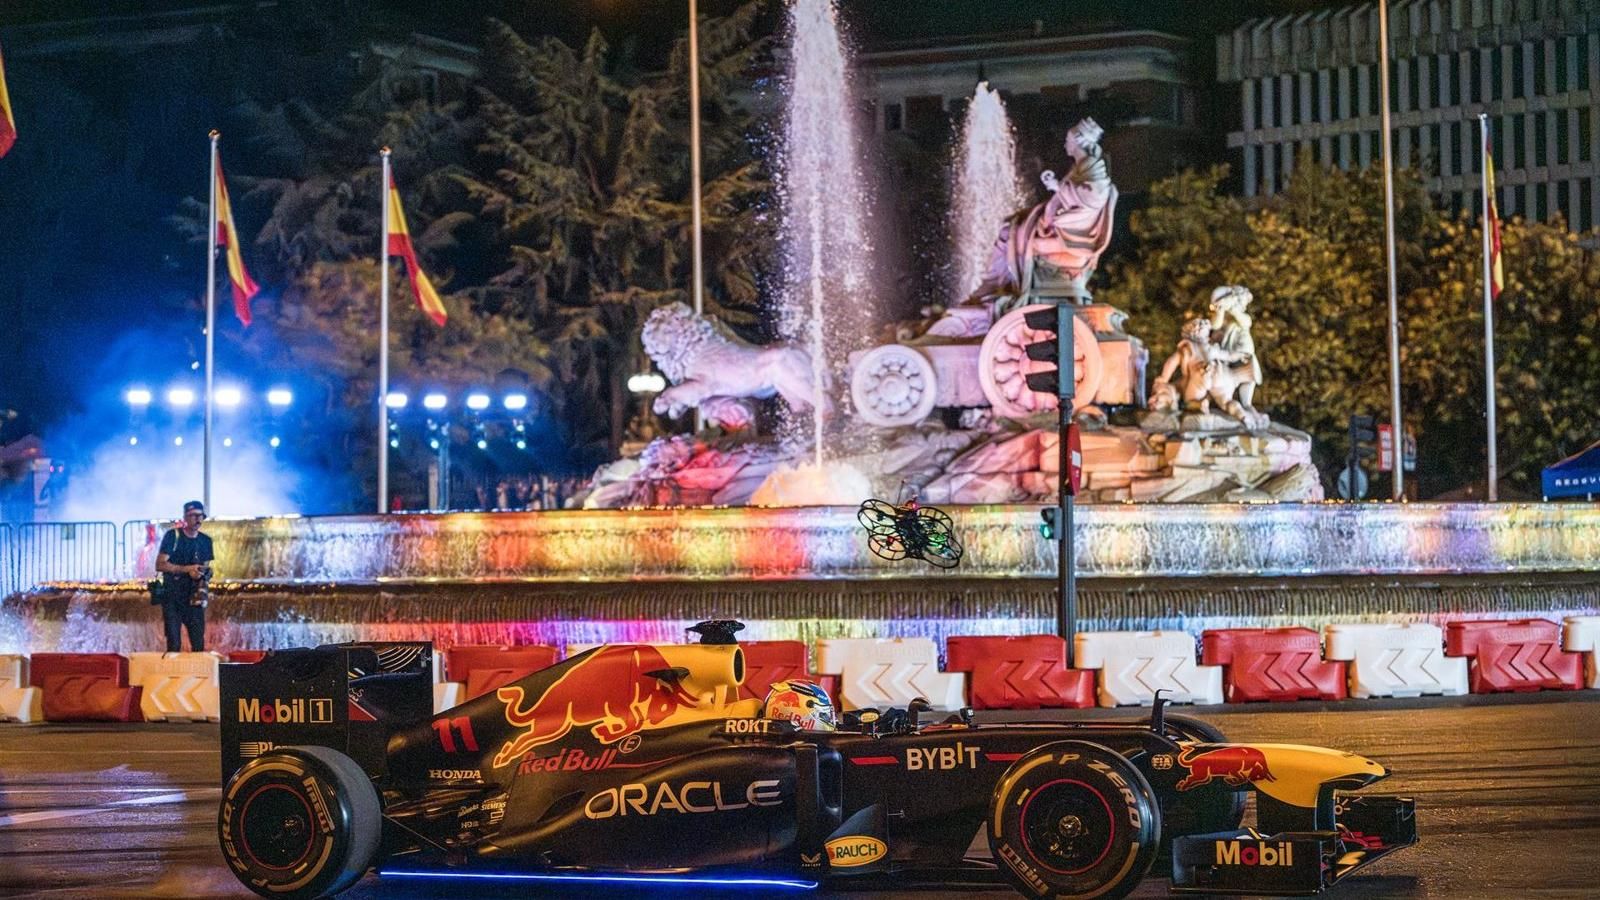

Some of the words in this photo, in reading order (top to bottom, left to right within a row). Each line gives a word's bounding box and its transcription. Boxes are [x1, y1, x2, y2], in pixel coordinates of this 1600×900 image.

[238, 698, 305, 724] Mobil
[432, 716, 480, 753] 11
[725, 719, 772, 733] ROKT
[519, 748, 567, 776] Red
[562, 748, 618, 771] Bull
[906, 742, 981, 771] BYBIT
[1152, 755, 1173, 769] FIA
[429, 769, 482, 780] HONDA
[585, 779, 784, 820] ORACLE
[1059, 753, 1080, 765] P
[1087, 759, 1142, 829] ZERO
[481, 801, 507, 811] SIEMENS
[836, 843, 878, 859] RAUCH
[1215, 840, 1294, 866] Mobil
